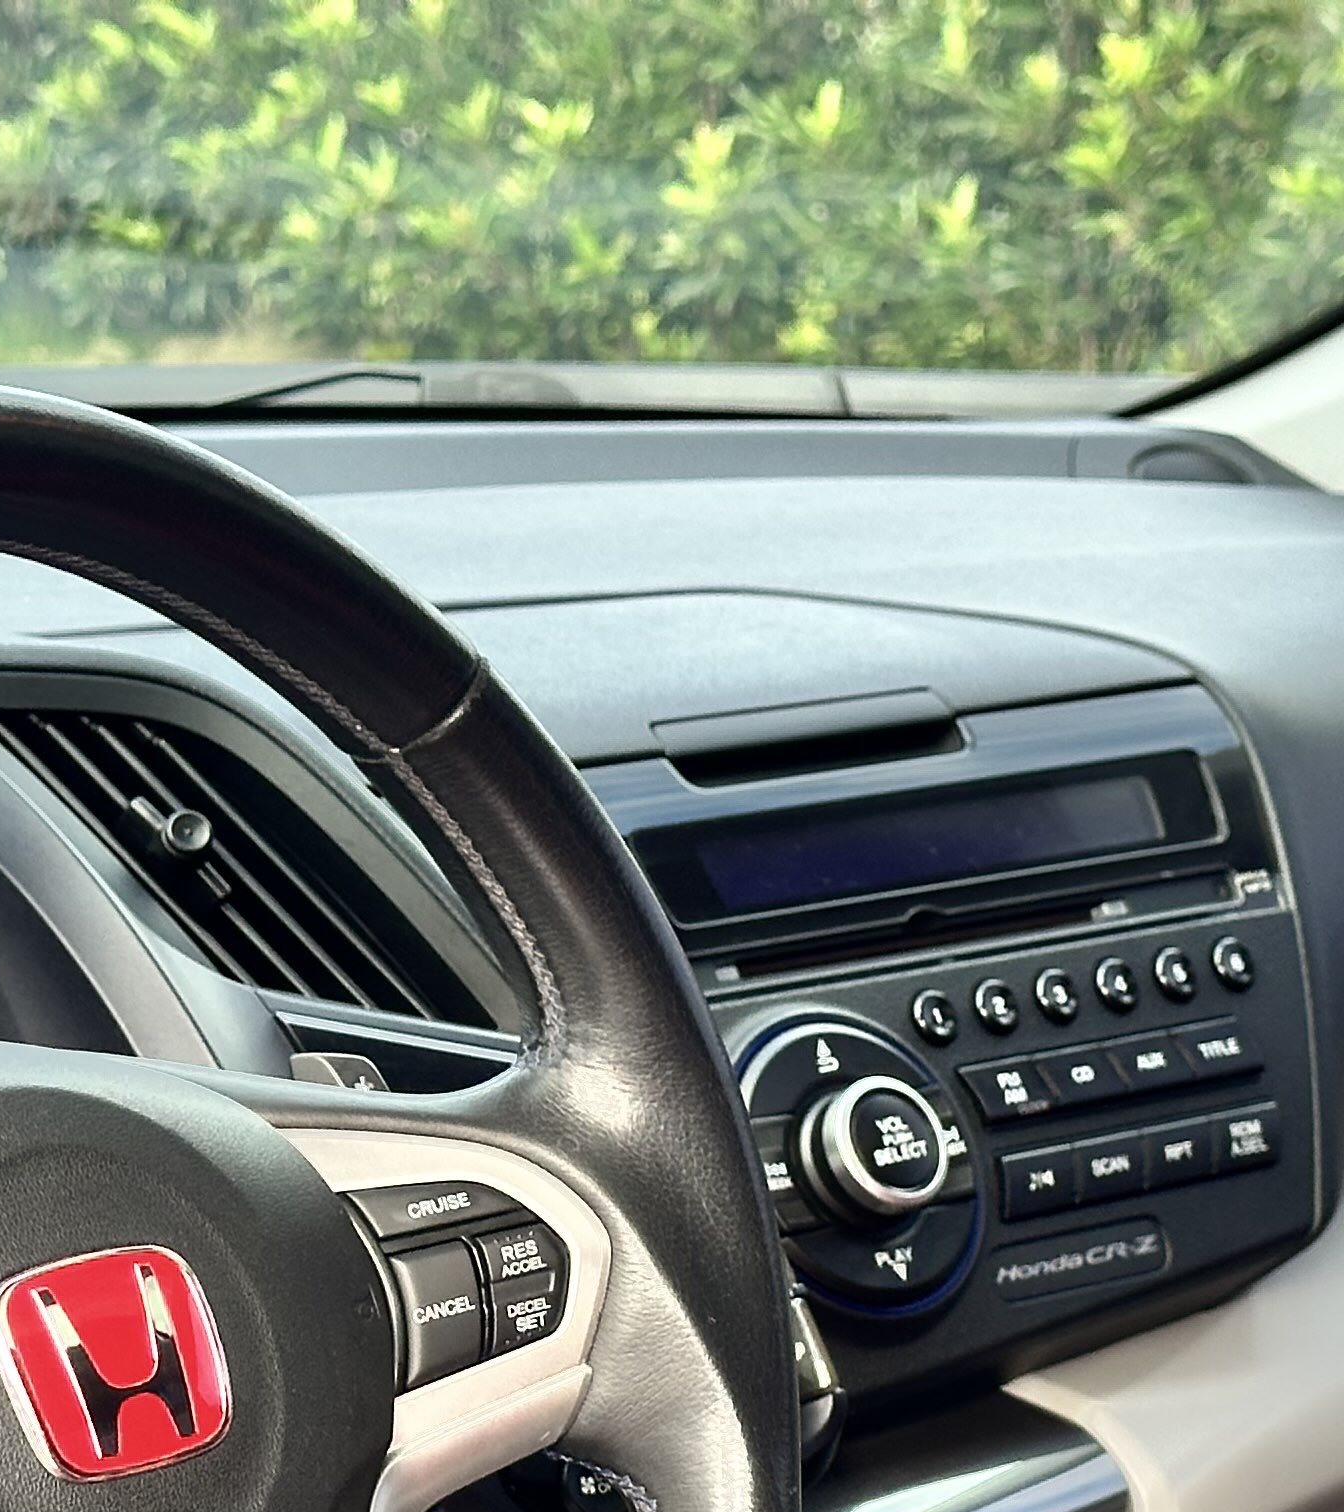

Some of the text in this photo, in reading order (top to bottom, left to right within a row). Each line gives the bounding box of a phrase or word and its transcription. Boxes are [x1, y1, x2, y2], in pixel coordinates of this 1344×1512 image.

[1070, 1064, 1095, 1084] CD
[875, 1115, 909, 1134] VOL
[873, 1139, 928, 1167] SELECT
[1091, 1154, 1131, 1178] SCAN
[407, 1191, 472, 1220] CRUISE
[500, 1238, 539, 1263] RES
[874, 1246, 913, 1268] PLAY
[501, 1256, 548, 1279] ACCEL
[412, 1295, 476, 1325] CANCEL
[507, 1296, 552, 1319] DECEL
[515, 1311, 547, 1333] SET
